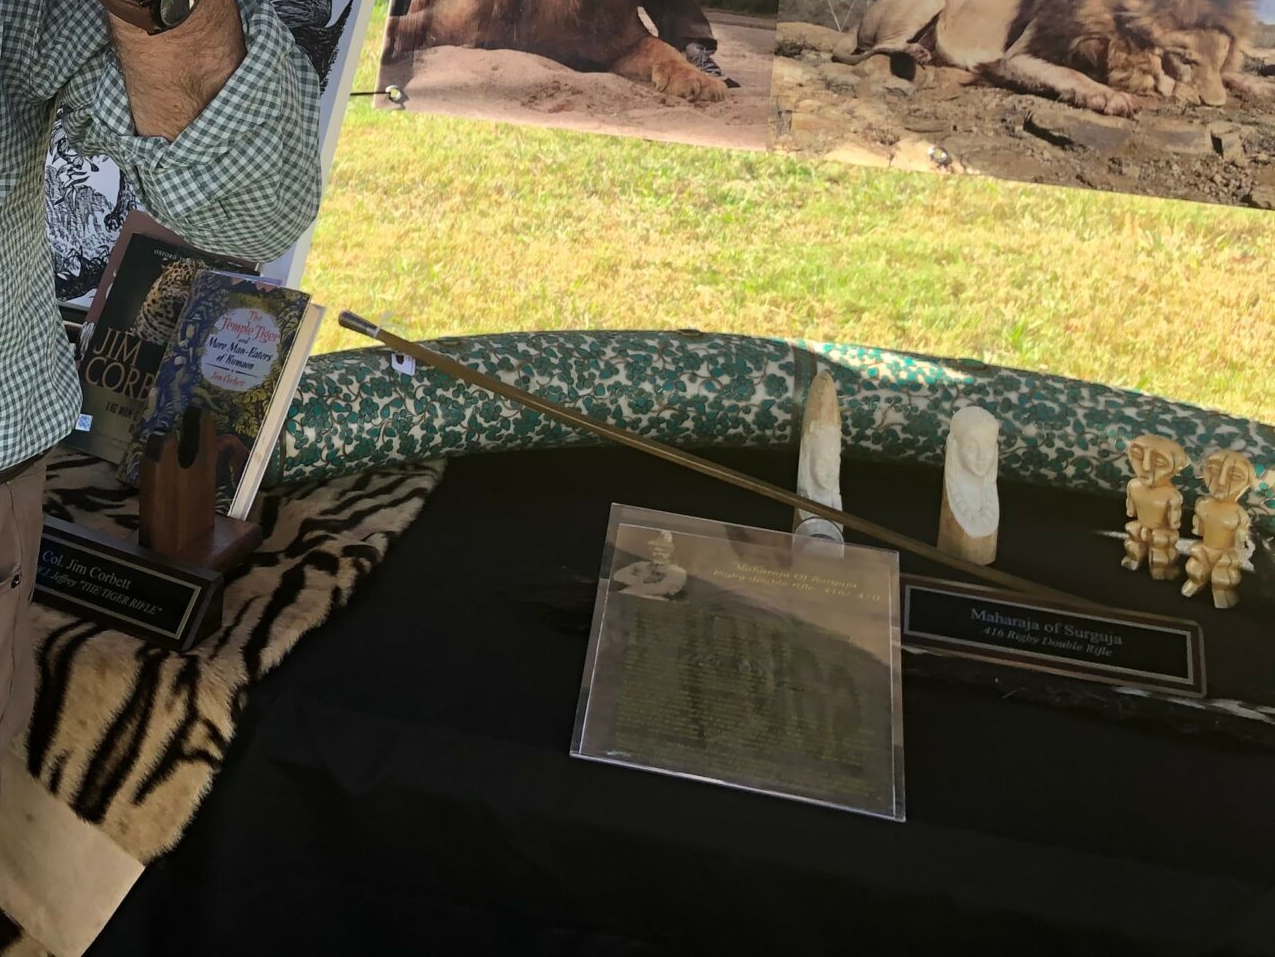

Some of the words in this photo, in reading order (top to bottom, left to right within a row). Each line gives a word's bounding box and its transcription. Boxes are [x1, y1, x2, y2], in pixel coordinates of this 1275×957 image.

[250, 309, 262, 322] The
[219, 316, 254, 339] Temple
[253, 325, 280, 343] Tiger
[93, 328, 142, 367] JIM
[208, 337, 228, 350] More
[227, 342, 274, 362] Man-Eaters
[216, 354, 226, 362] of
[85, 356, 155, 401] CORB
[42, 550, 64, 567] Col.
[65, 559, 87, 576] Jim
[89, 566, 132, 591] Corbett
[101, 589, 131, 605] TIGER
[970, 608, 1040, 632] Maharaja
[1044, 622, 1062, 634] of
[1064, 624, 1123, 646] Surguja
[1007, 630, 1039, 645] Rigby
[1041, 636, 1084, 652] Double
[1086, 643, 1114, 657] Rifle
